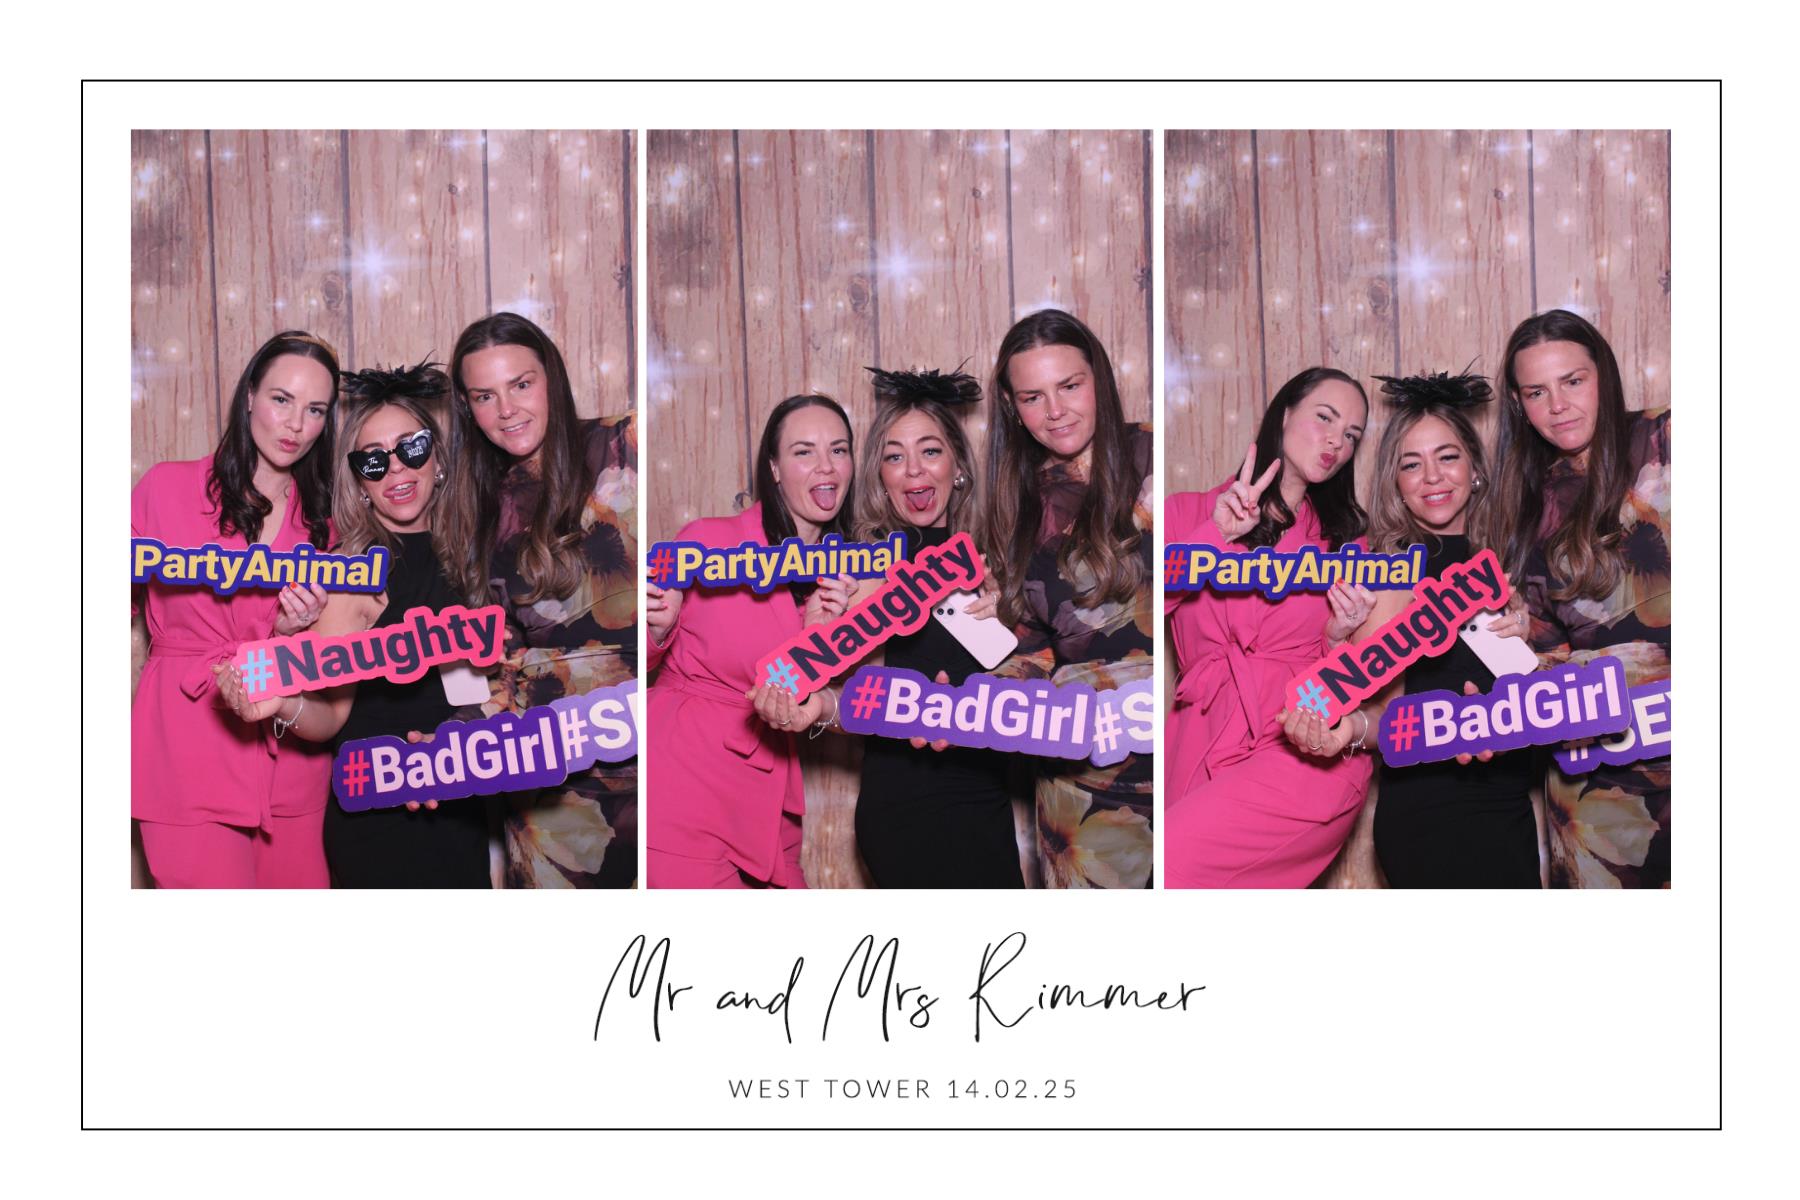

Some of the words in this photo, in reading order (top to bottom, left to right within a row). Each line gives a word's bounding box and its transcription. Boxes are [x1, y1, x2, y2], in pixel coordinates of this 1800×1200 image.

[134, 544, 383, 589] PartyAnimal
[650, 537, 902, 587] #PartyAnimal
[1164, 550, 1422, 593] #PartyAnimal
[240, 613, 497, 694] #Naughty
[765, 539, 976, 696] #Naughty
[1295, 558, 1503, 719] #Naughty
[559, 692, 638, 761] #S
[850, 675, 1088, 745] #BadGirl
[1389, 666, 1621, 753] #BadGirl
[343, 717, 558, 797] #BadGirl
